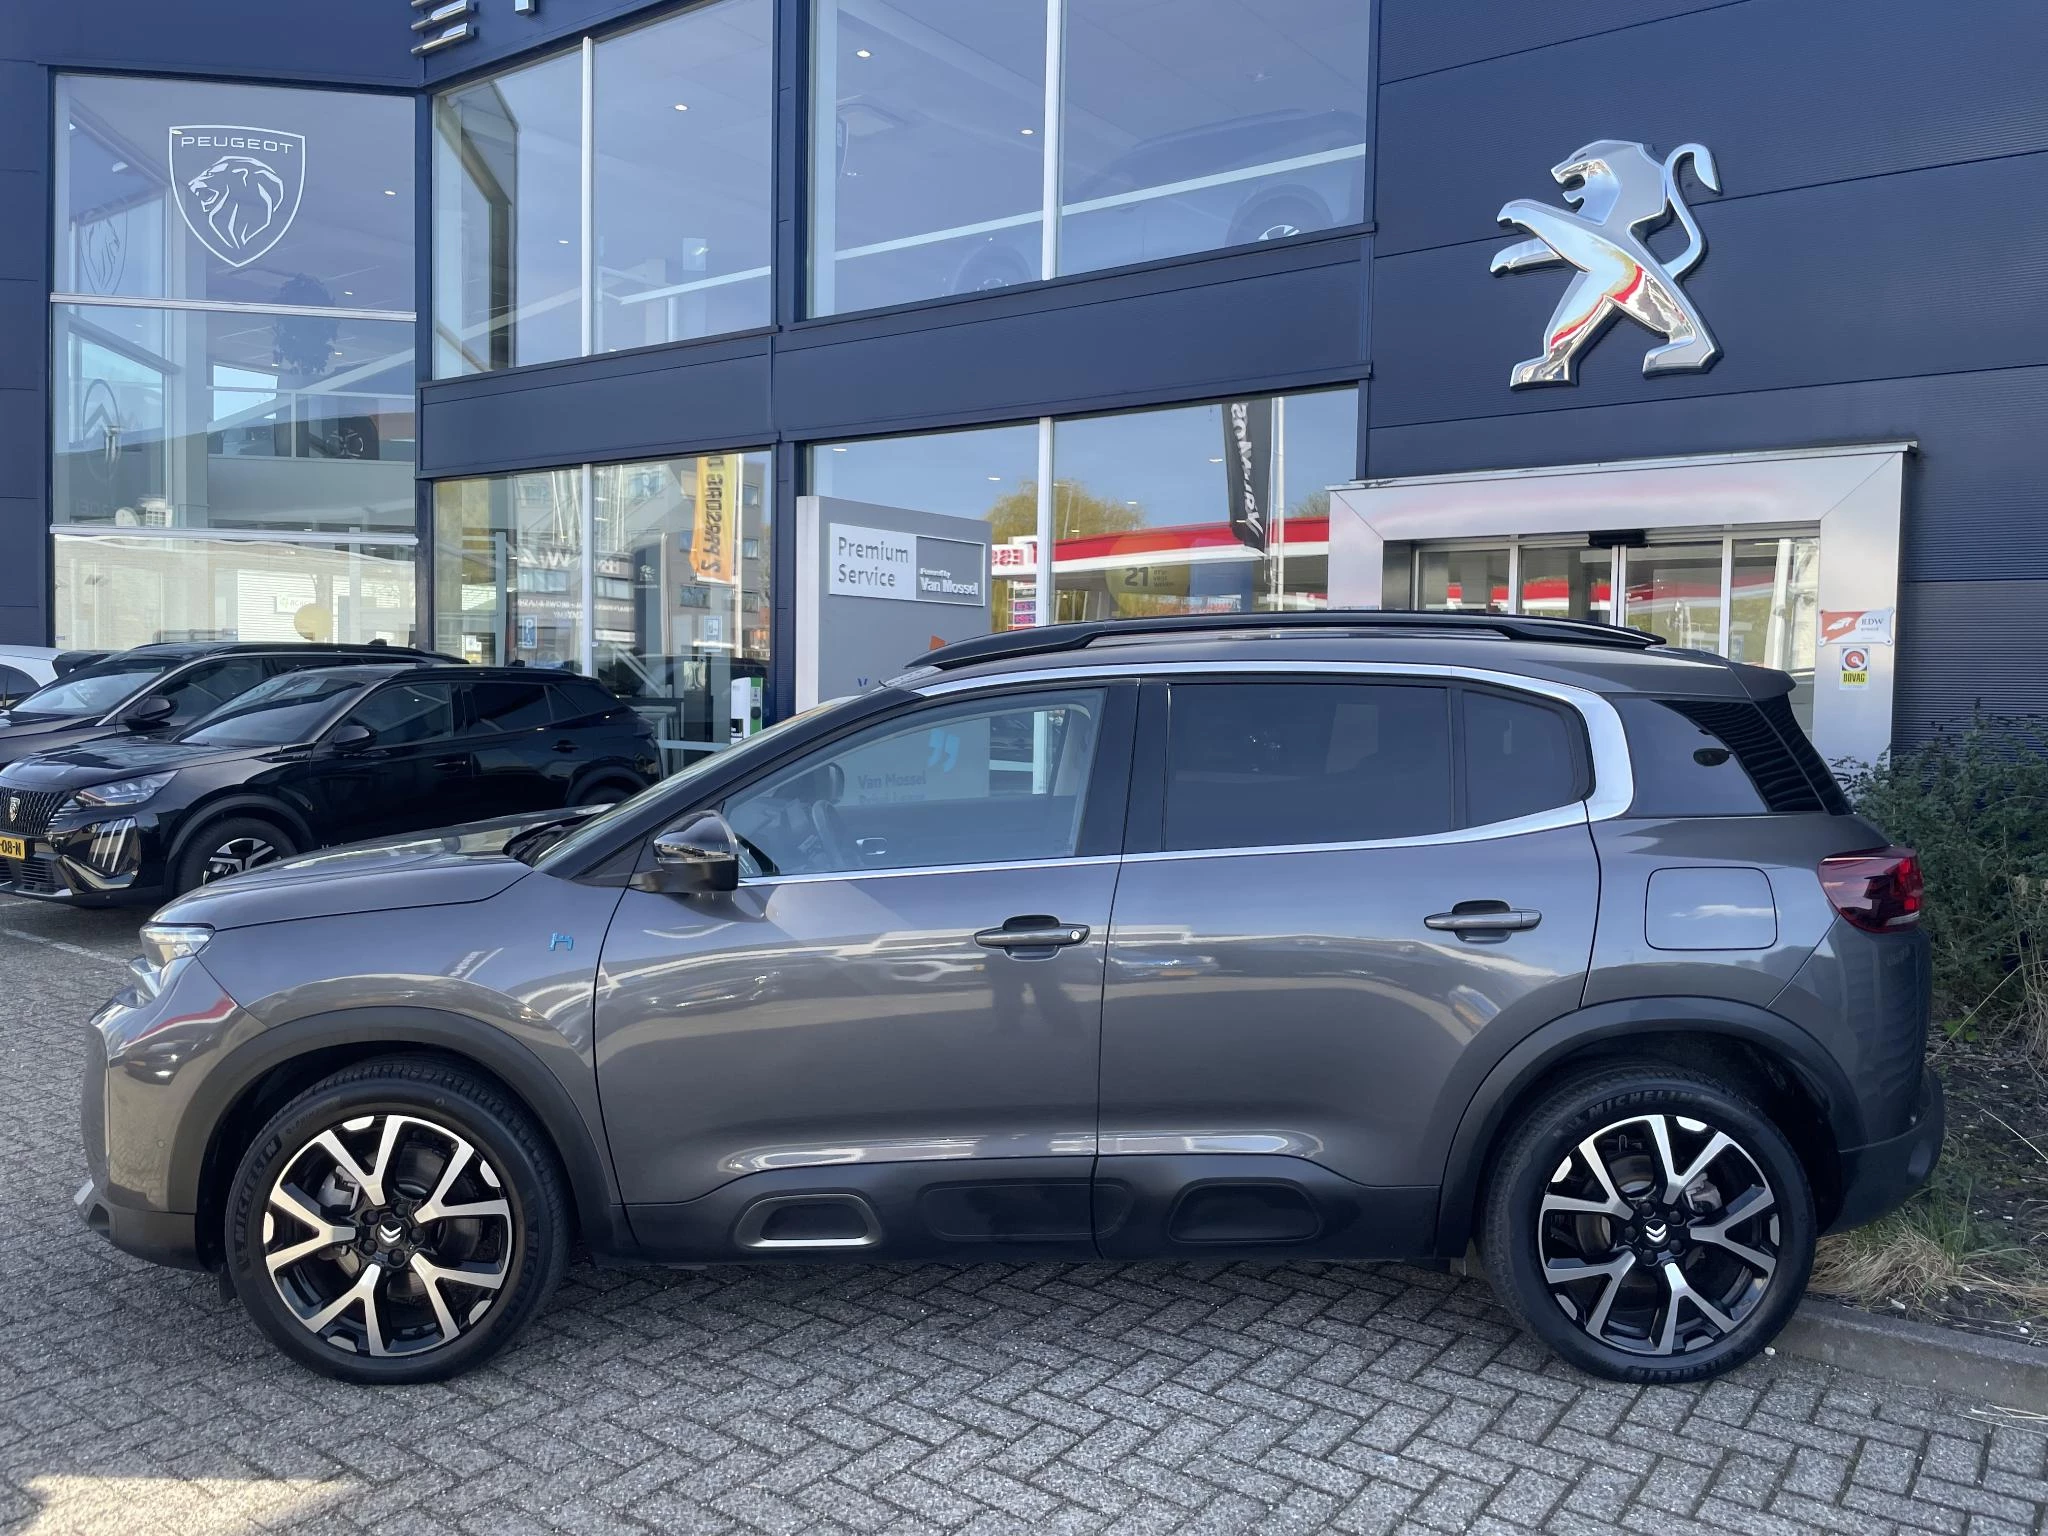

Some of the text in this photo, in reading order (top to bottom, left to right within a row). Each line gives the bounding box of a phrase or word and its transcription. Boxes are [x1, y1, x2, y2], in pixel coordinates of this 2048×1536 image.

[181, 136, 293, 154] PEUGEOT
[838, 536, 909, 563] Premium
[838, 563, 896, 587] Service
[920, 576, 979, 595] Van Mossel
[1125, 566, 1149, 587] 21
[858, 775, 882, 789] Van
[235, 1134, 281, 1242] MICHELIN
